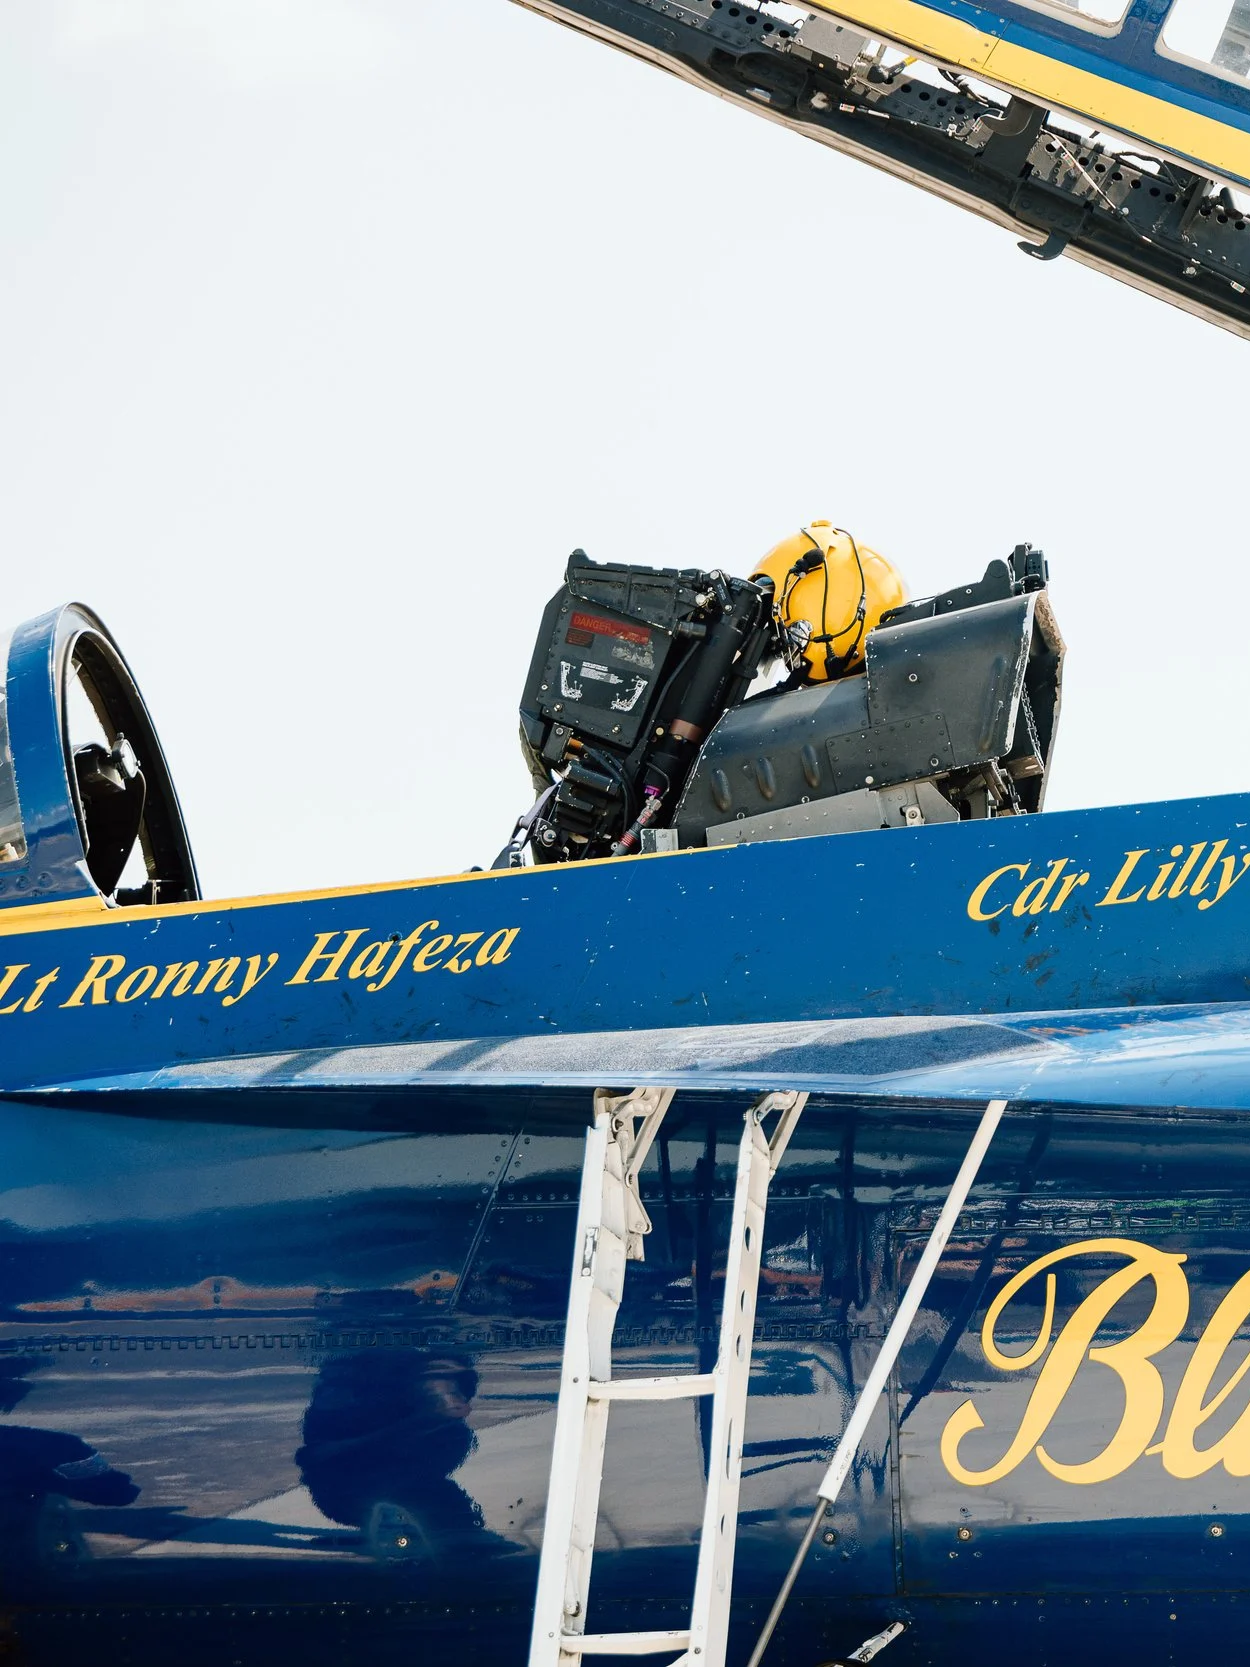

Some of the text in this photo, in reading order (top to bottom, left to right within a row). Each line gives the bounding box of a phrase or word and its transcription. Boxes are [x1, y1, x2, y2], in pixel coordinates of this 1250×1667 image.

[573, 614, 612, 633] DANGER
[966, 857, 1089, 921] Cdr
[0, 919, 521, 1014] Lt Ronny Hafeza
